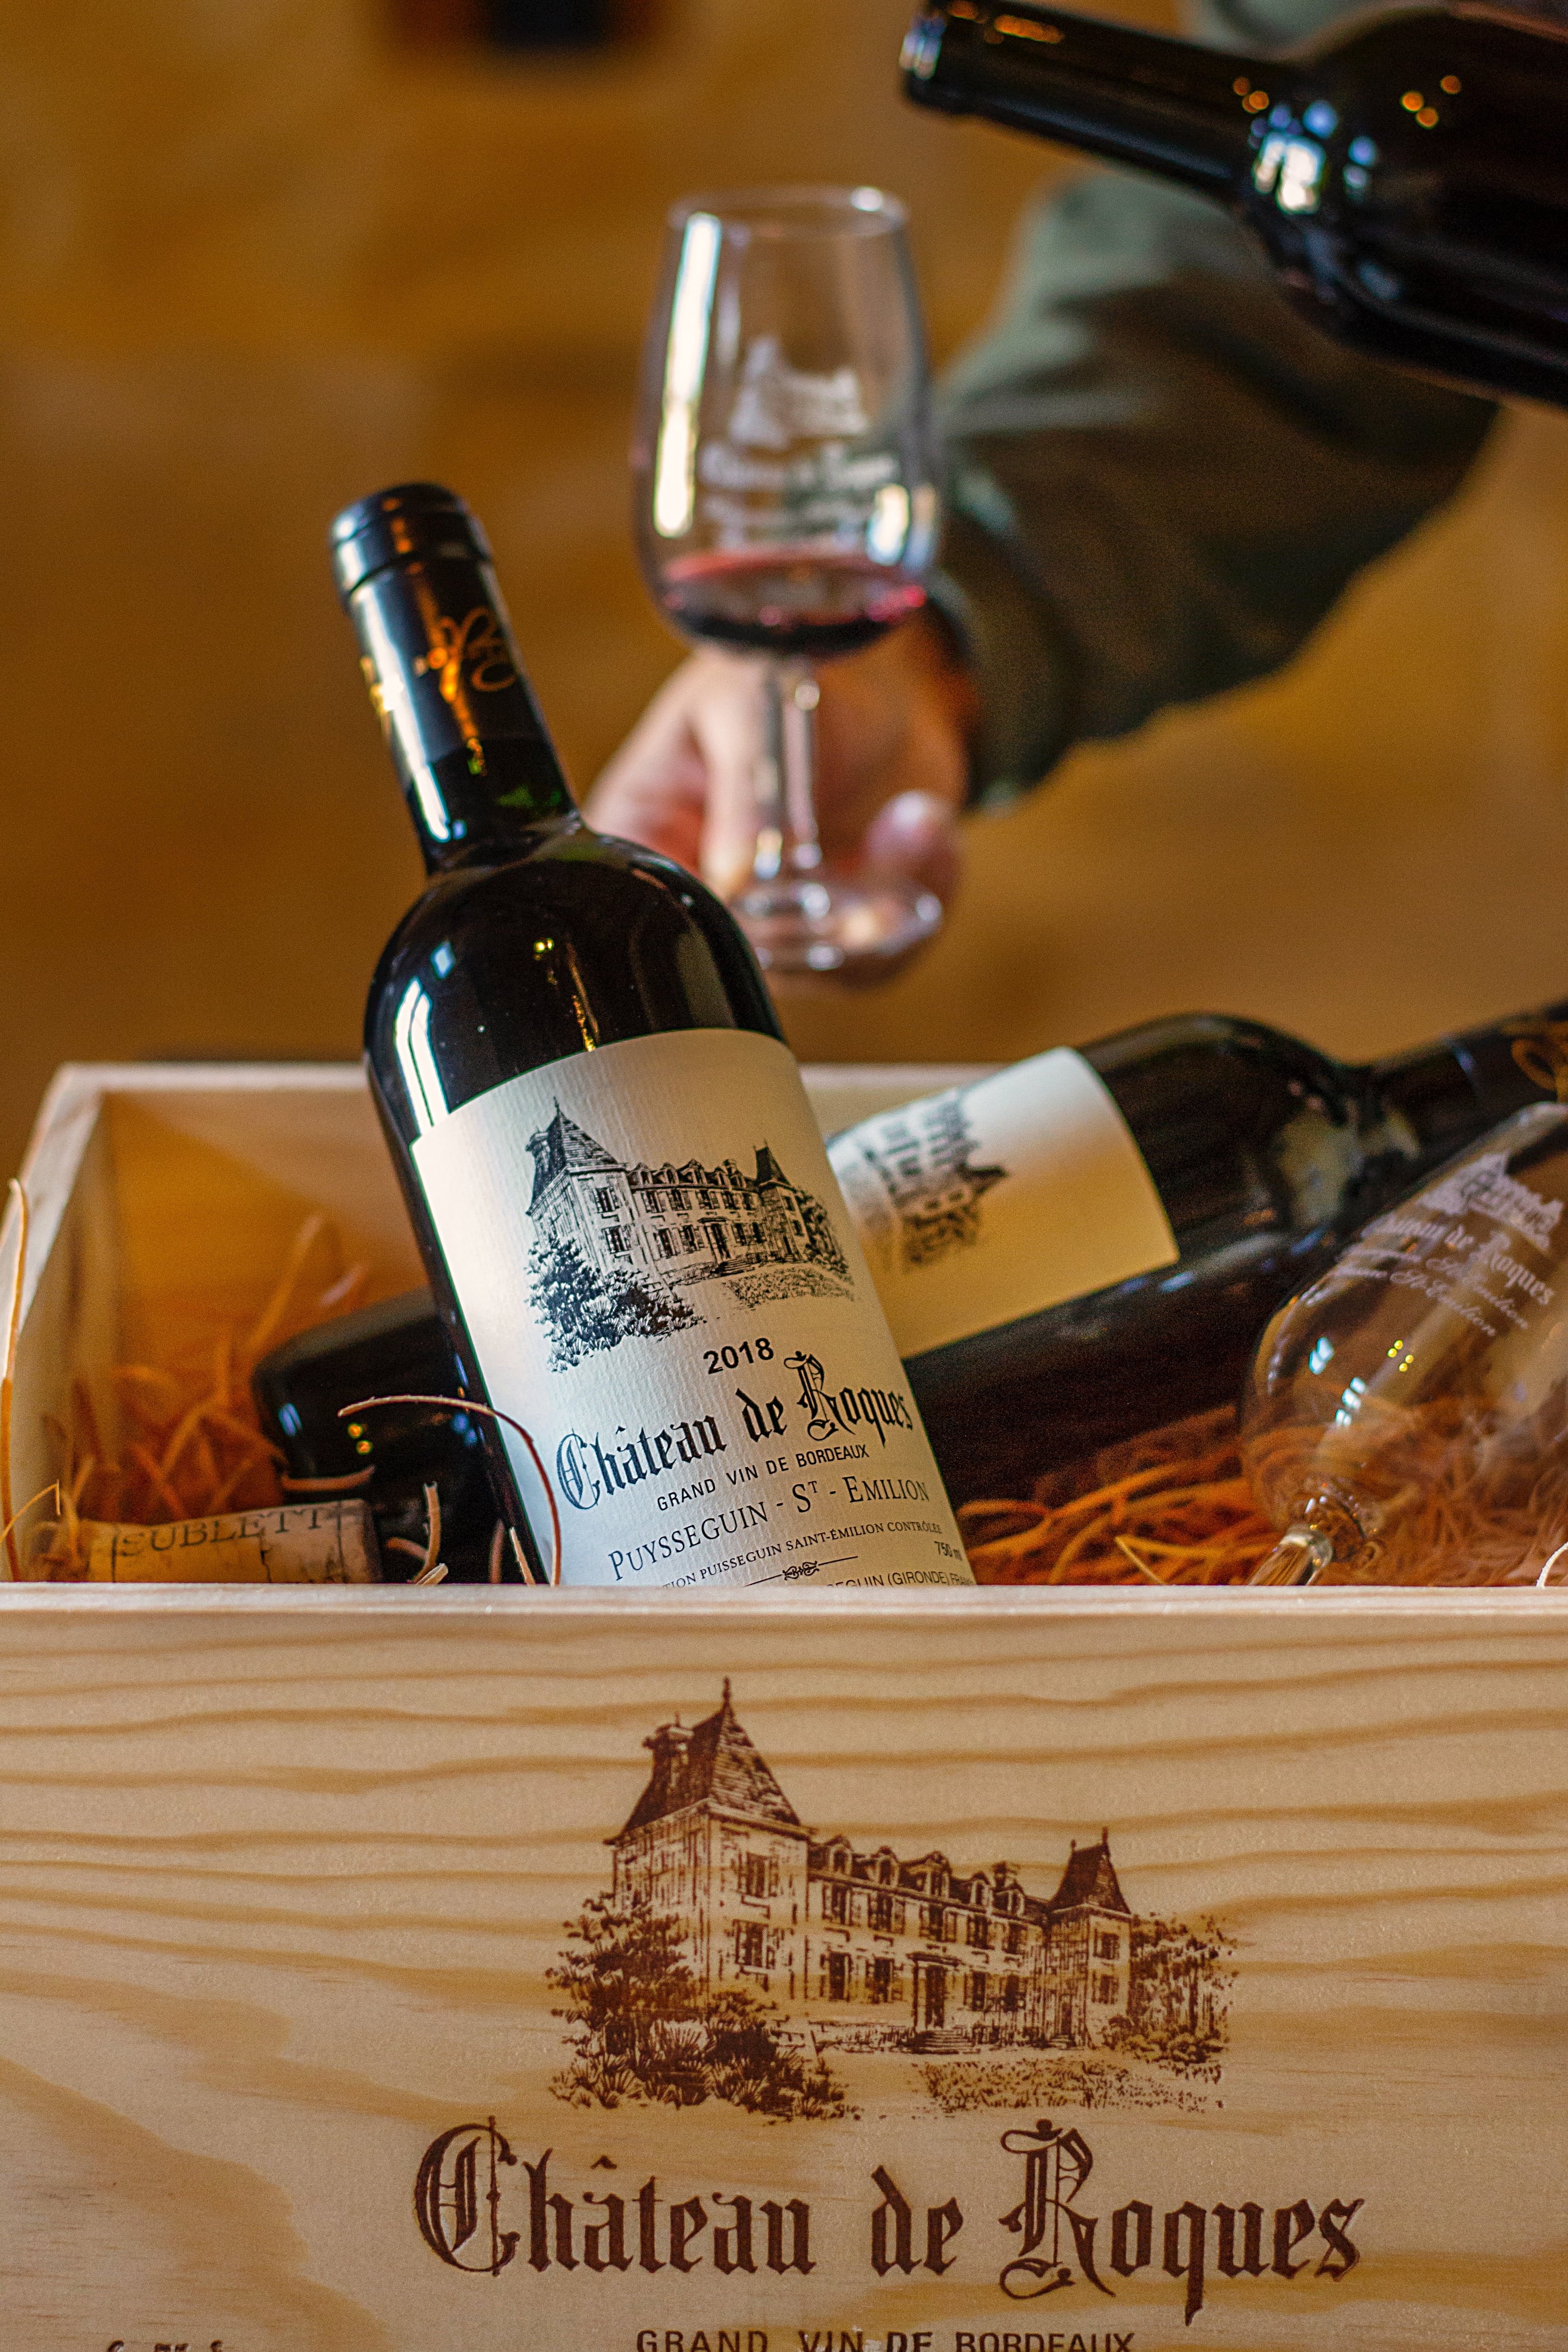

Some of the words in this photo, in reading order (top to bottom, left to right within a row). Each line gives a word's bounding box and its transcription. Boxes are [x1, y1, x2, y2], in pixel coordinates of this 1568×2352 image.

[703, 1337, 774, 1375] 2018
[556, 1414, 727, 1510] Château
[735, 1387, 788, 1443] de
[783, 1351, 914, 1449] Roques
[657, 1478, 716, 1511] GRAND
[726, 1464, 758, 1486] VIN
[766, 1456, 790, 1475] DE
[795, 1444, 870, 1468] BORDEAUX
[608, 1501, 769, 1582] PUYSSEGUIN
[842, 1476, 930, 1503] EMILION
[699, 1543, 782, 1580] PUISSEGUIN
[786, 1522, 885, 1552] SAINT-ÉMILION
[933, 1540, 952, 1558] 750
[413, 2116, 817, 2277] Château
[870, 2164, 965, 2277] de
[998, 2118, 1365, 2328] Roques
[636, 2329, 769, 2352] GRAND
[797, 2330, 864, 2352] VIN
[887, 2331, 934, 2352] DE
[955, 2331, 1136, 2352] BORDEAUX
